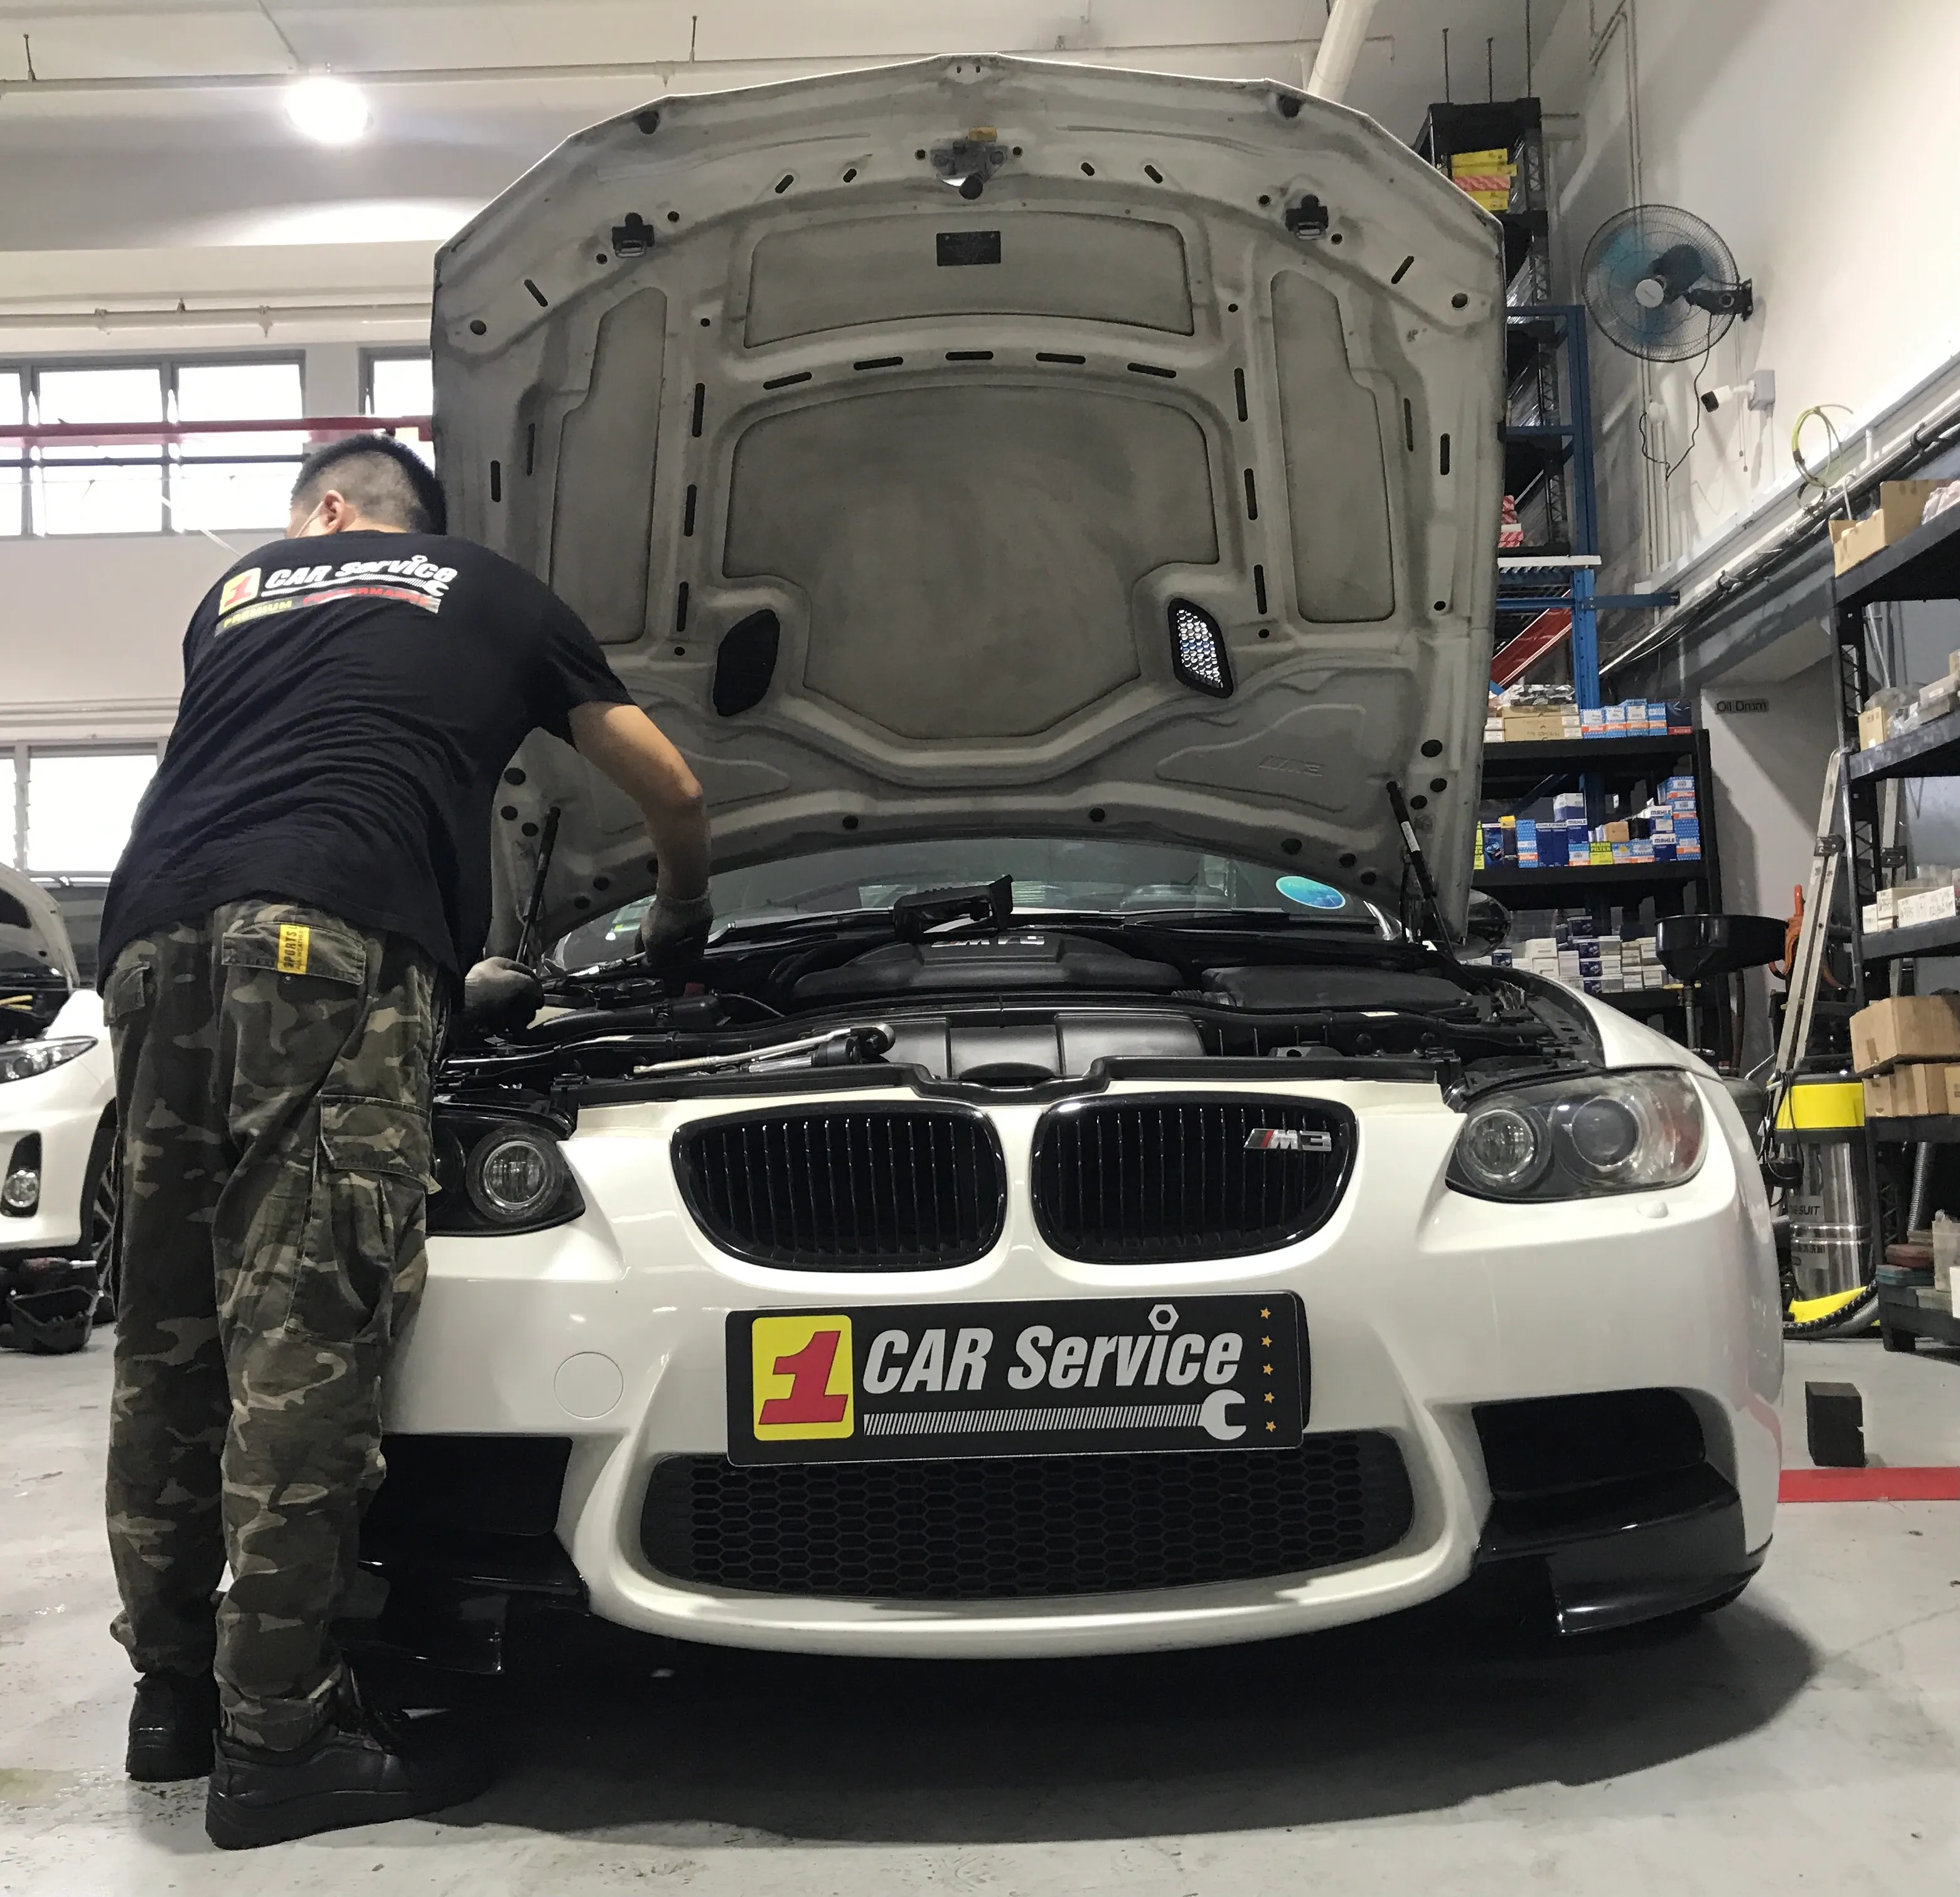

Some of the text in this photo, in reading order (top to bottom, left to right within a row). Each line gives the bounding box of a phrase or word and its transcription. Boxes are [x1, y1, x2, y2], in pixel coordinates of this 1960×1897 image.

[224, 555, 458, 607] 1 CAR Service
[223, 601, 292, 628] PREMIUM
[1716, 700, 1767, 712] Oil Drum
[1266, 1129, 1332, 1152] M3
[758, 1304, 1243, 1425] 1 CAR Service
